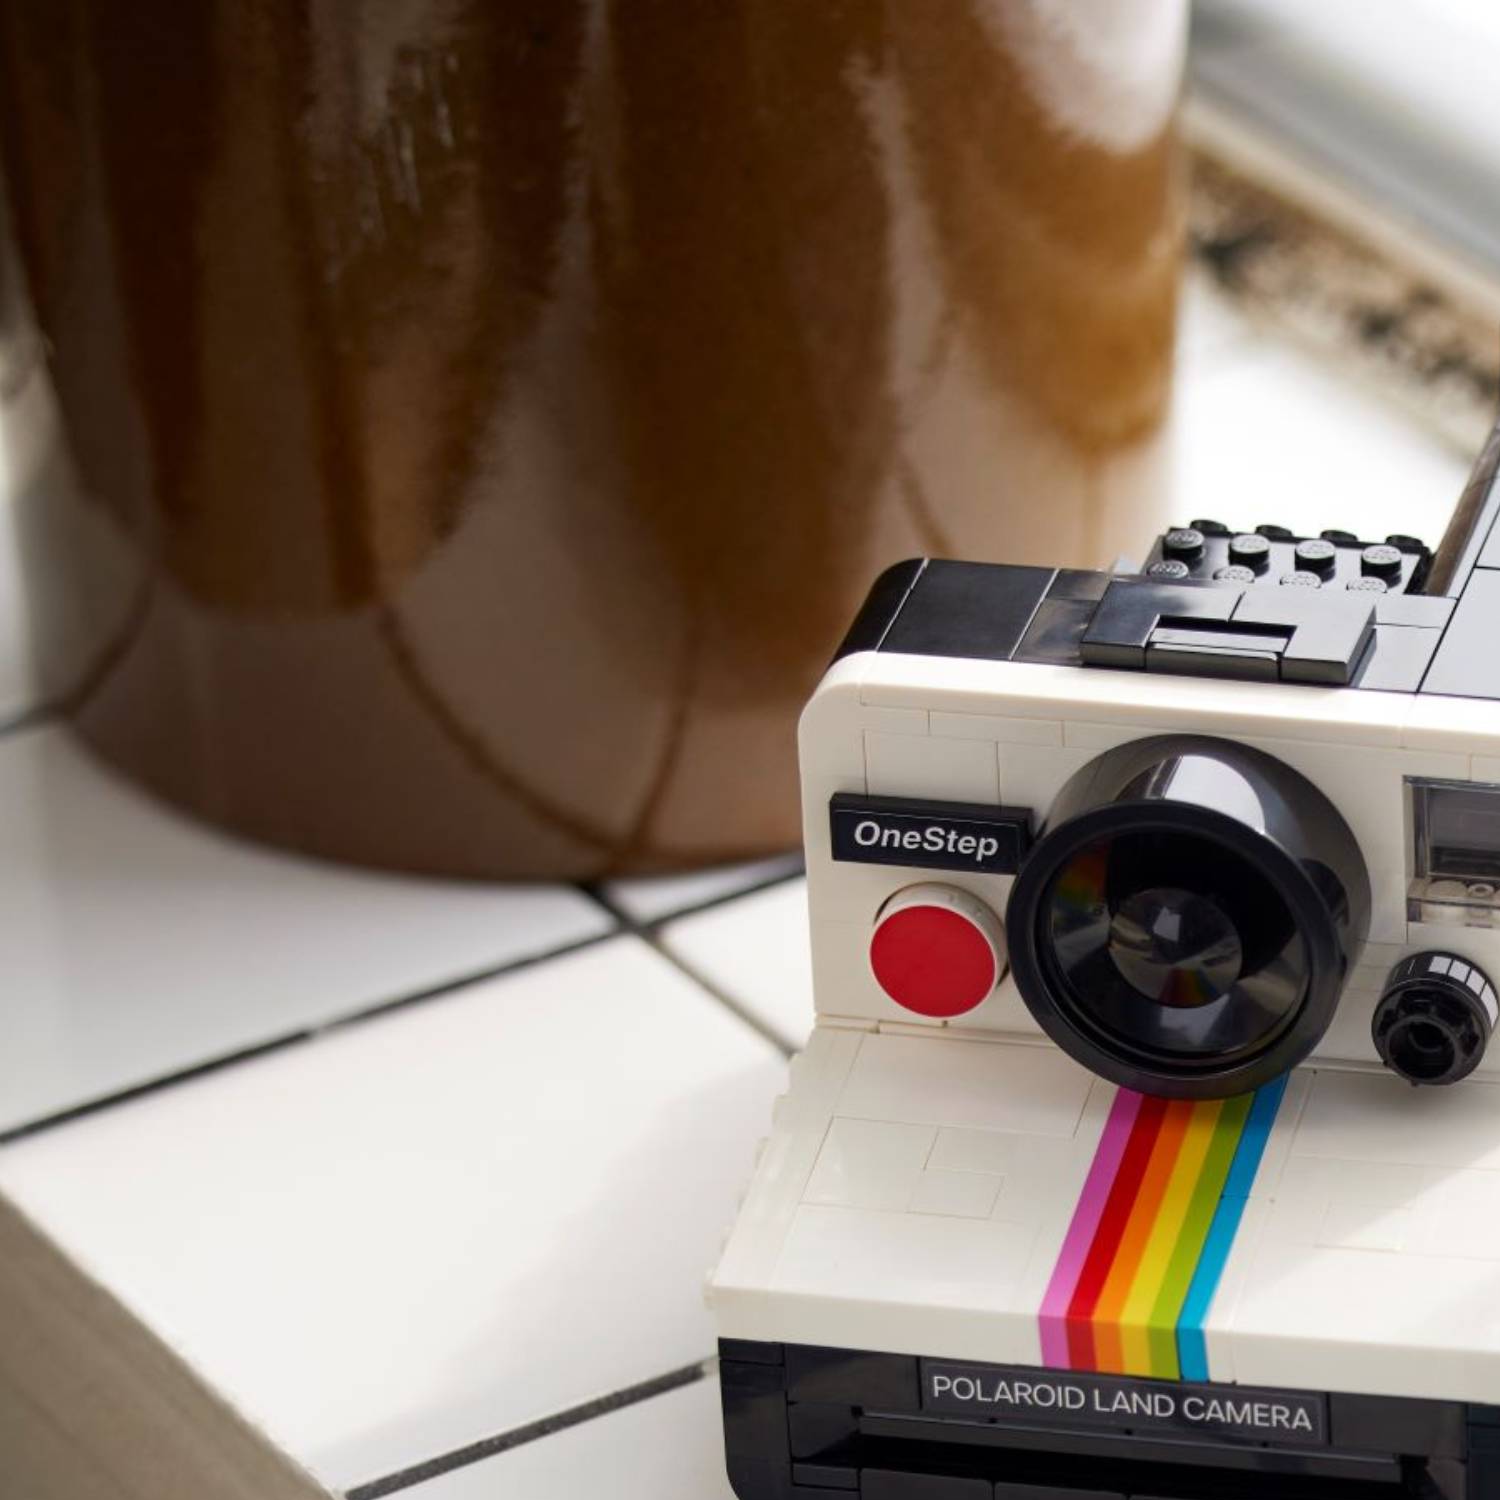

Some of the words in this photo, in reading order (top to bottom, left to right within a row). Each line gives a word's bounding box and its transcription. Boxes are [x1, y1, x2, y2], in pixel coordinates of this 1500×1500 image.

[853, 820, 999, 861] OneStep
[932, 1374, 1087, 1411] POLAROID
[1094, 1388, 1176, 1418] LAND
[1183, 1397, 1314, 1432] CAMERA
